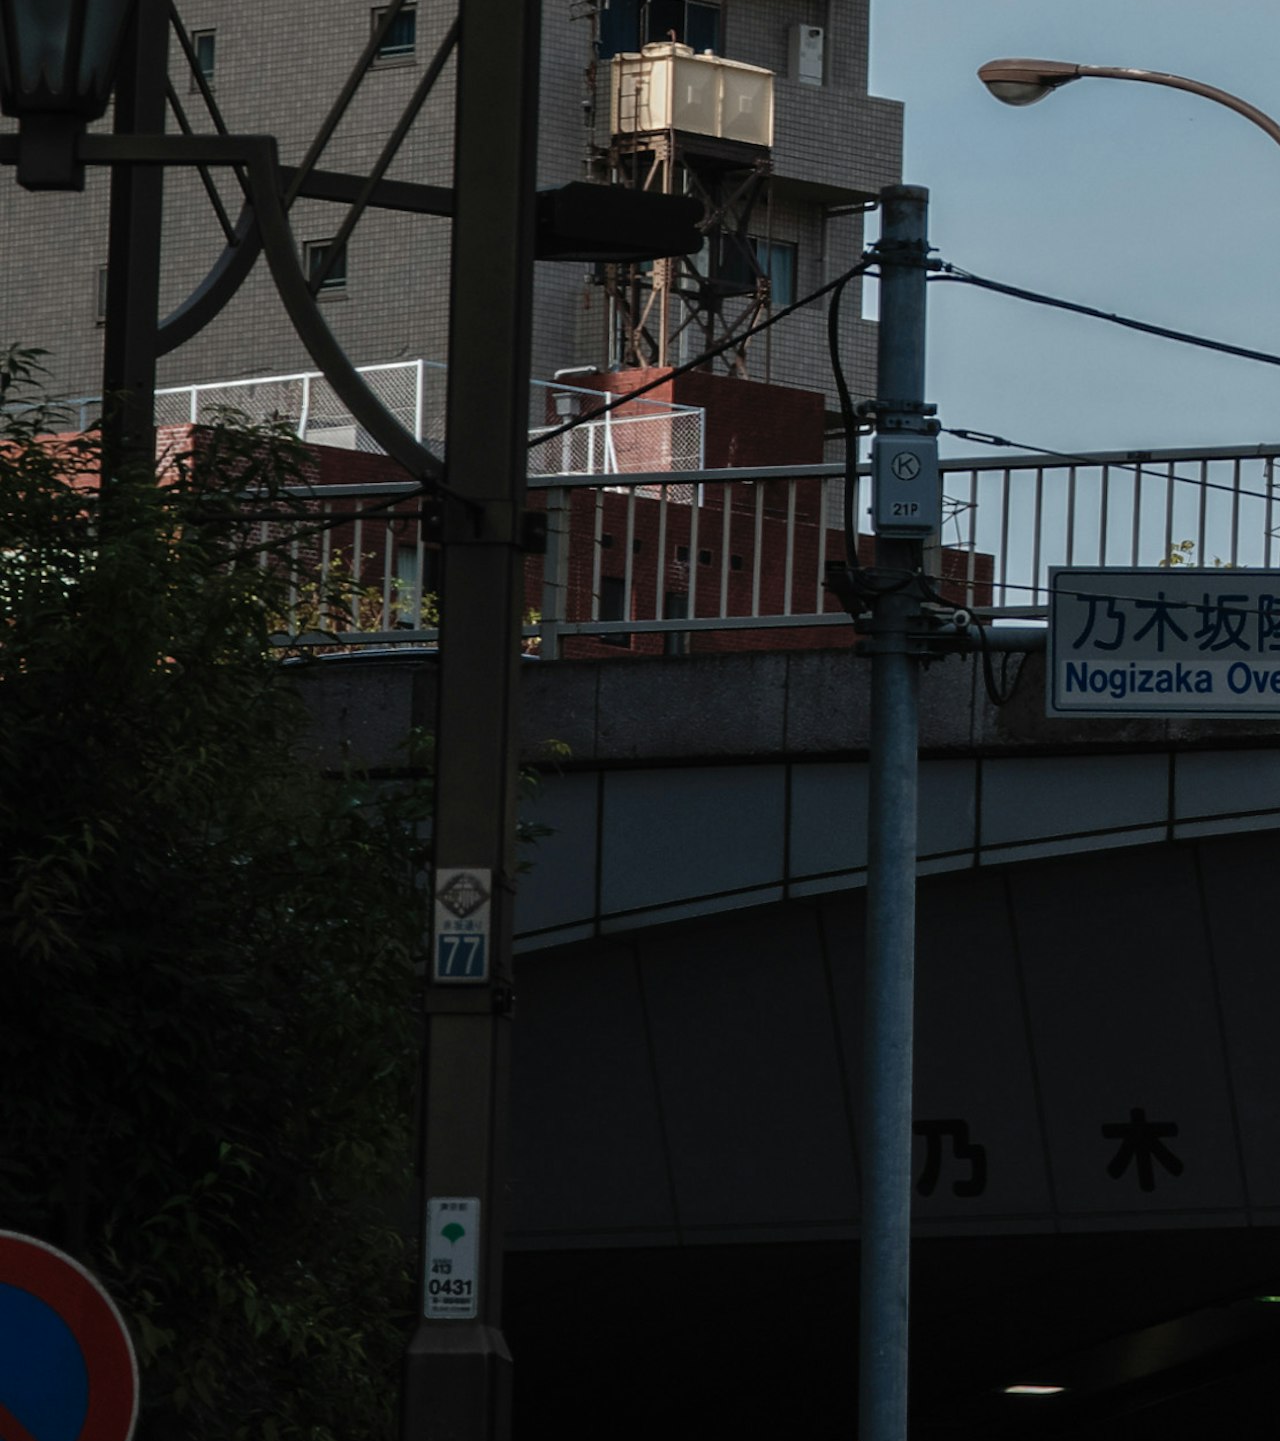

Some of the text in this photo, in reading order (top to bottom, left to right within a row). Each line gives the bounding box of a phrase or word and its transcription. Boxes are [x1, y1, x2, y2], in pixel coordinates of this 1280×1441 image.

[893, 502, 918, 517] 21P
[1066, 662, 1213, 698] Nogizaka
[443, 936, 480, 975] 77
[429, 1279, 472, 1295] 0431
